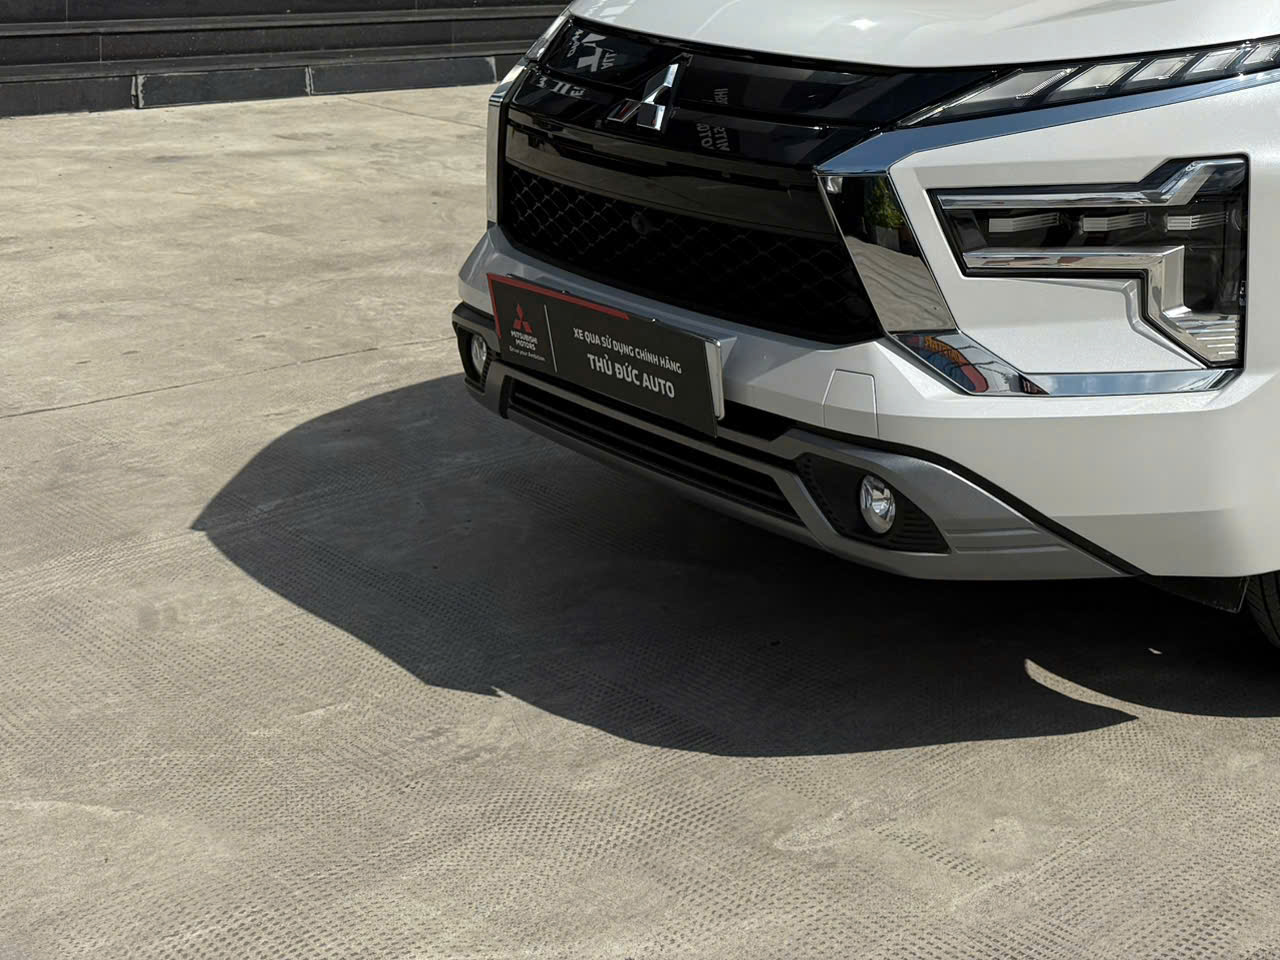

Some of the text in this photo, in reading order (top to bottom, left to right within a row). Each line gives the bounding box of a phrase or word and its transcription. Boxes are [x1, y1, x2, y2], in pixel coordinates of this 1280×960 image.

[511, 330, 538, 345] MITSUBISHI
[515, 339, 536, 351] MOTORS
[573, 327, 682, 375] XE QUA SỬ DỤNG CHÍNH HÃNG
[587, 353, 675, 399] THỦ ĐỨC AUTO
